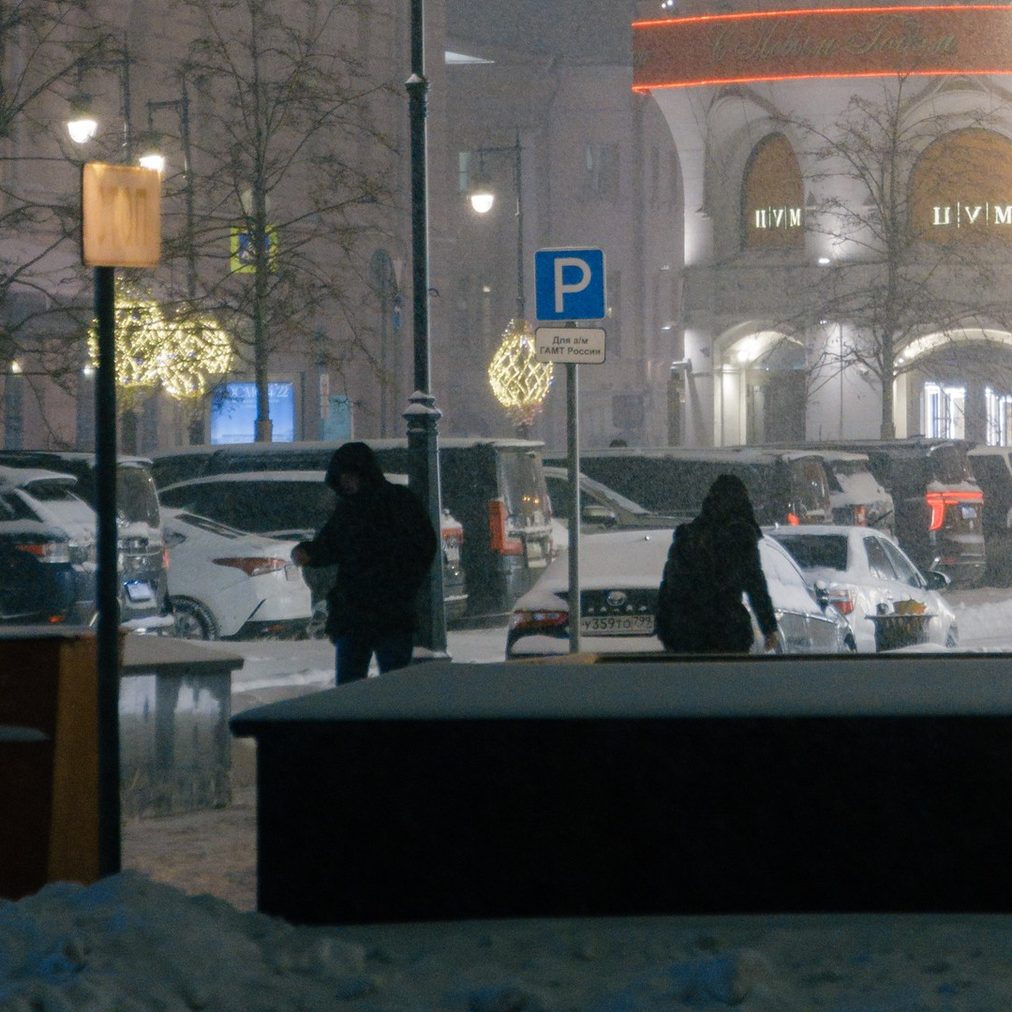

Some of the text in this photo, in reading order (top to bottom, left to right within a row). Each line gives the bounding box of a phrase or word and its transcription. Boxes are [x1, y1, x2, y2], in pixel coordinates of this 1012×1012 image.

[554, 256, 592, 314] P
[552, 335, 589, 345] Для а/м
[539, 346, 601, 355] ГАМТ России
